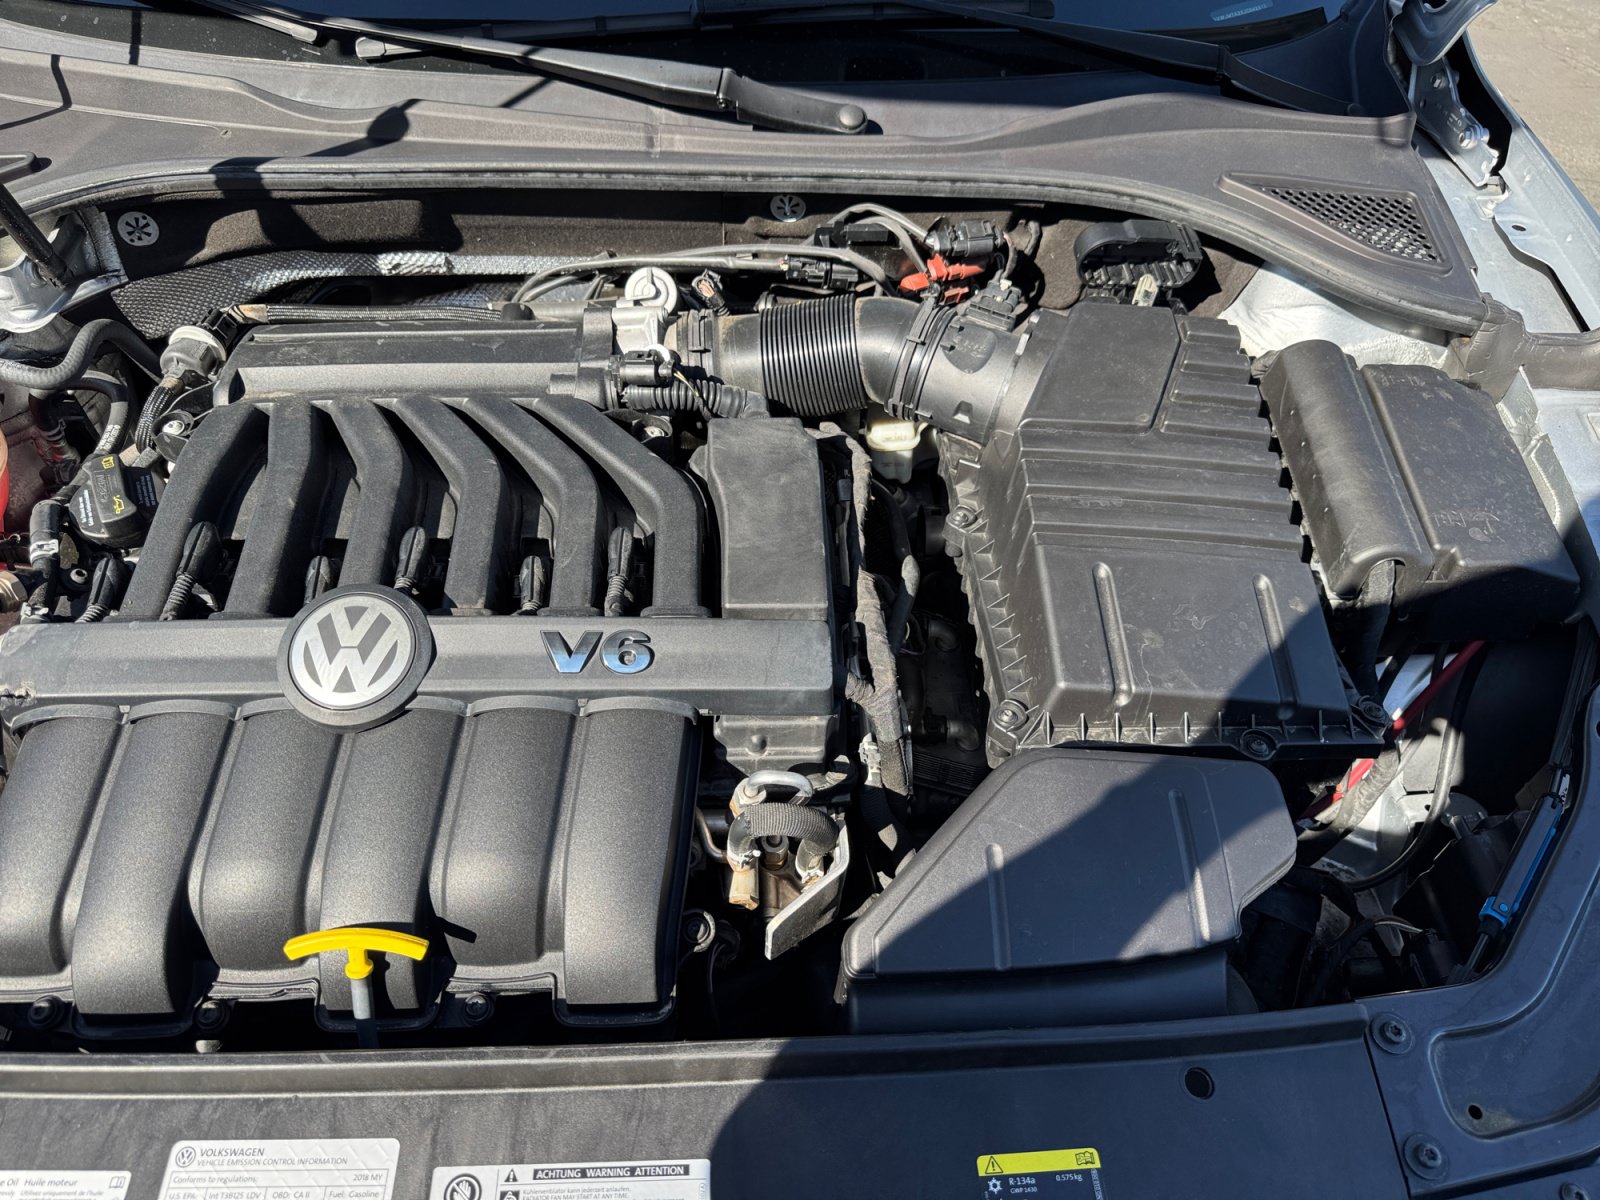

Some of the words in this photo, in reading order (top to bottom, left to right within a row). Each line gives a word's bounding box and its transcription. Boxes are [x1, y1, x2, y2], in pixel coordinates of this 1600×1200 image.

[539, 629, 655, 674] V6
[200, 1148, 264, 1157] VOLKSWAGEN
[197, 1158, 225, 1166] VEHICLE
[227, 1158, 260, 1166] EMISSION
[262, 1158, 296, 1166] CONTROL
[297, 1157, 348, 1165] INFORMATION
[536, 1169, 581, 1179] ACHTUNG
[586, 1167, 630, 1177] WARNING
[634, 1166, 684, 1176] ATTENTION
[7, 1178, 18, 1186] Oil
[24, 1178, 46, 1187] Huile
[47, 1178, 78, 1187] moteur
[173, 1176, 206, 1184] Conforms
[1009, 1177, 1036, 1186] R-134a
[246, 1191, 262, 1199] LDV
[293, 1191, 303, 1199] CA
[348, 1190, 379, 1198] Gasoline
